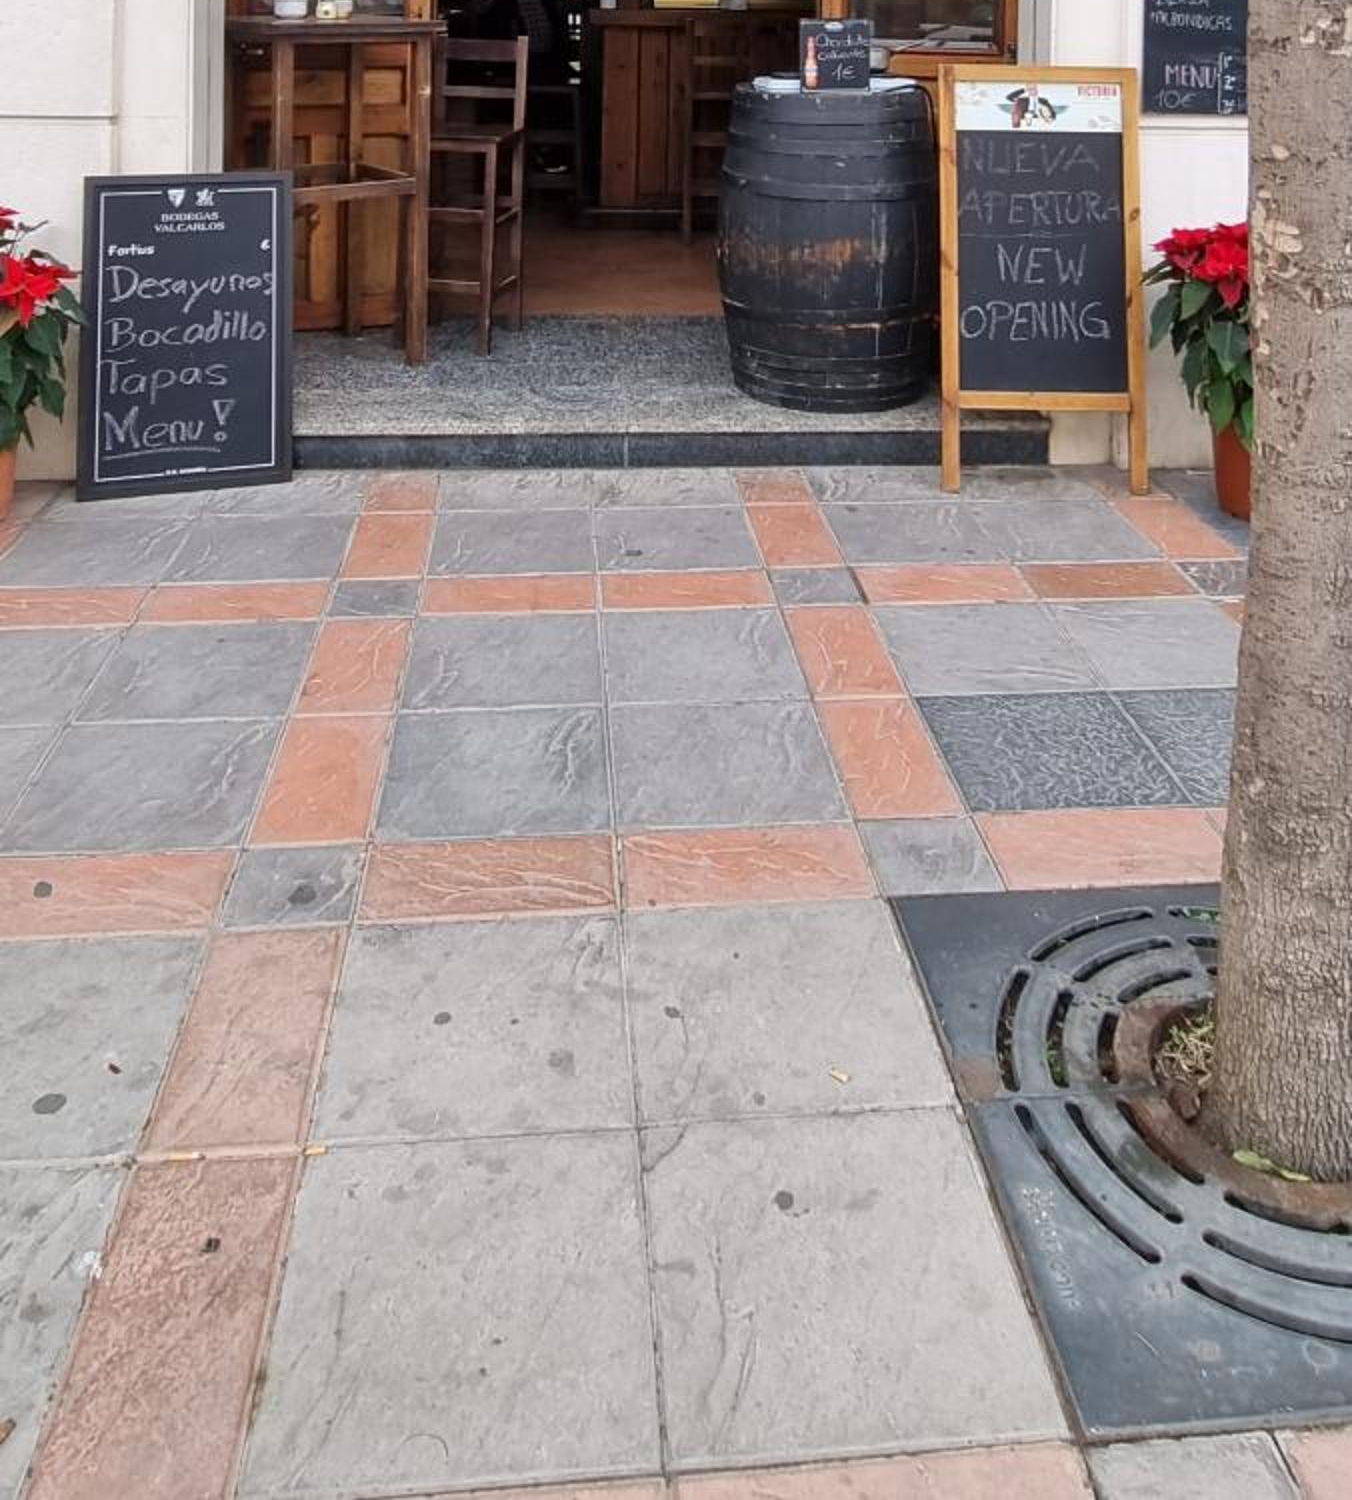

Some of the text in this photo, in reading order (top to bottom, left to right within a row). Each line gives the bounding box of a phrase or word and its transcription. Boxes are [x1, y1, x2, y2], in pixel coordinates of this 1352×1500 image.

[832, 62, 857, 81] 1€
[1164, 64, 1217, 89] MENU
[962, 137, 1099, 176] NUEVA
[160, 211, 220, 222] BODEGAS
[958, 188, 1121, 226] APERTURA
[153, 221, 226, 233] VALCARLOS
[107, 244, 155, 257] Fortius
[997, 244, 1087, 285] NEW
[104, 264, 274, 313] Desayunos
[103, 310, 267, 353] Bocadillo
[960, 301, 1112, 342] OPENING
[100, 359, 229, 404] Tapas
